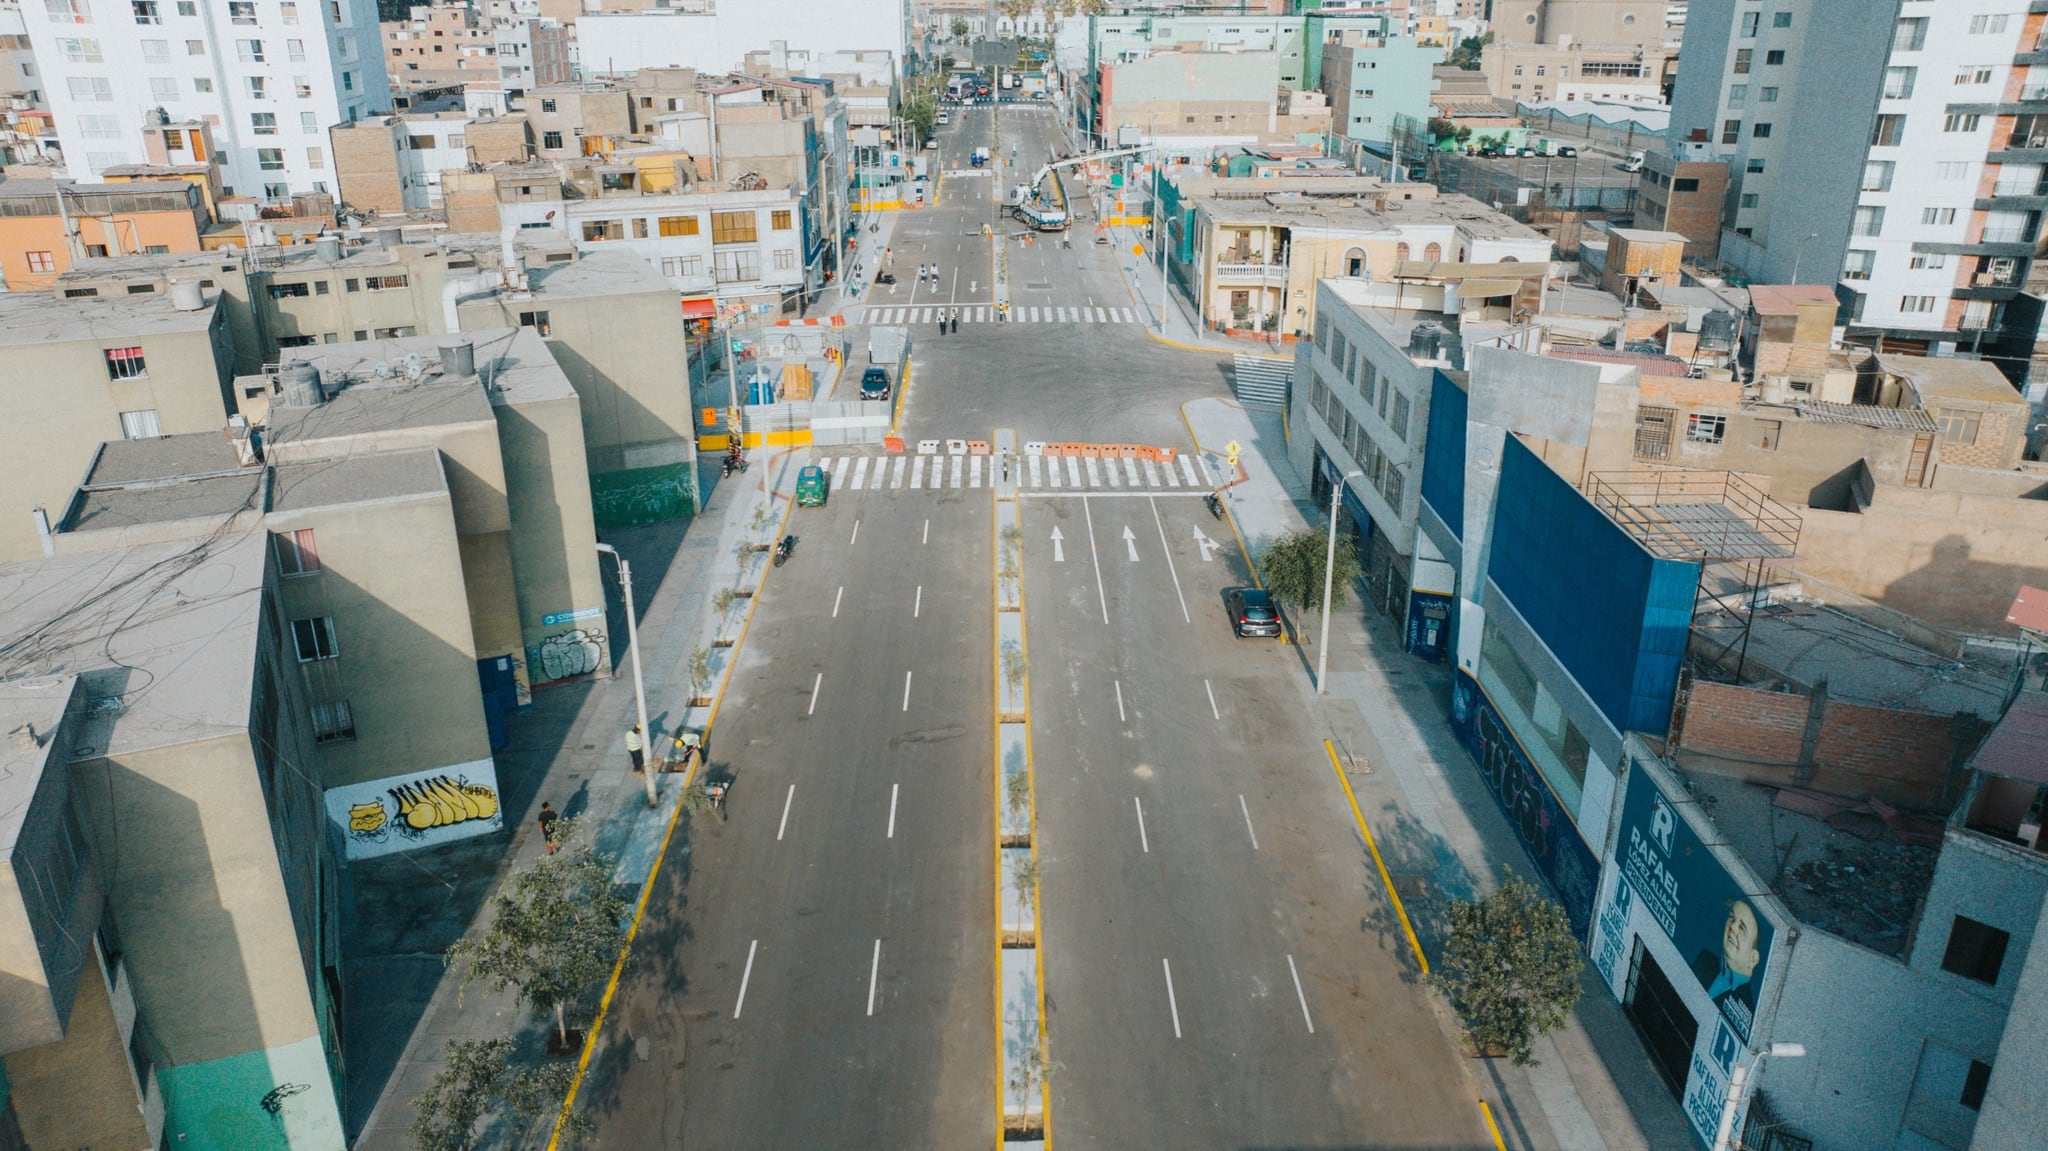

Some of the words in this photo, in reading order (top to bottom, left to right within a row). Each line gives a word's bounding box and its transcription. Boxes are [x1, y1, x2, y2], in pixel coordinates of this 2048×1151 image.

[1652, 798, 1673, 852] R
[1628, 846, 1650, 880] LÓPEZ
[1650, 878, 1677, 921] ALIAGA
[1630, 825, 1680, 906] RAFAEL
[1626, 861, 1675, 938] PRESIDENTE
[1694, 1053, 1717, 1100] RAFAEL
[1713, 1021, 1735, 1076] R
